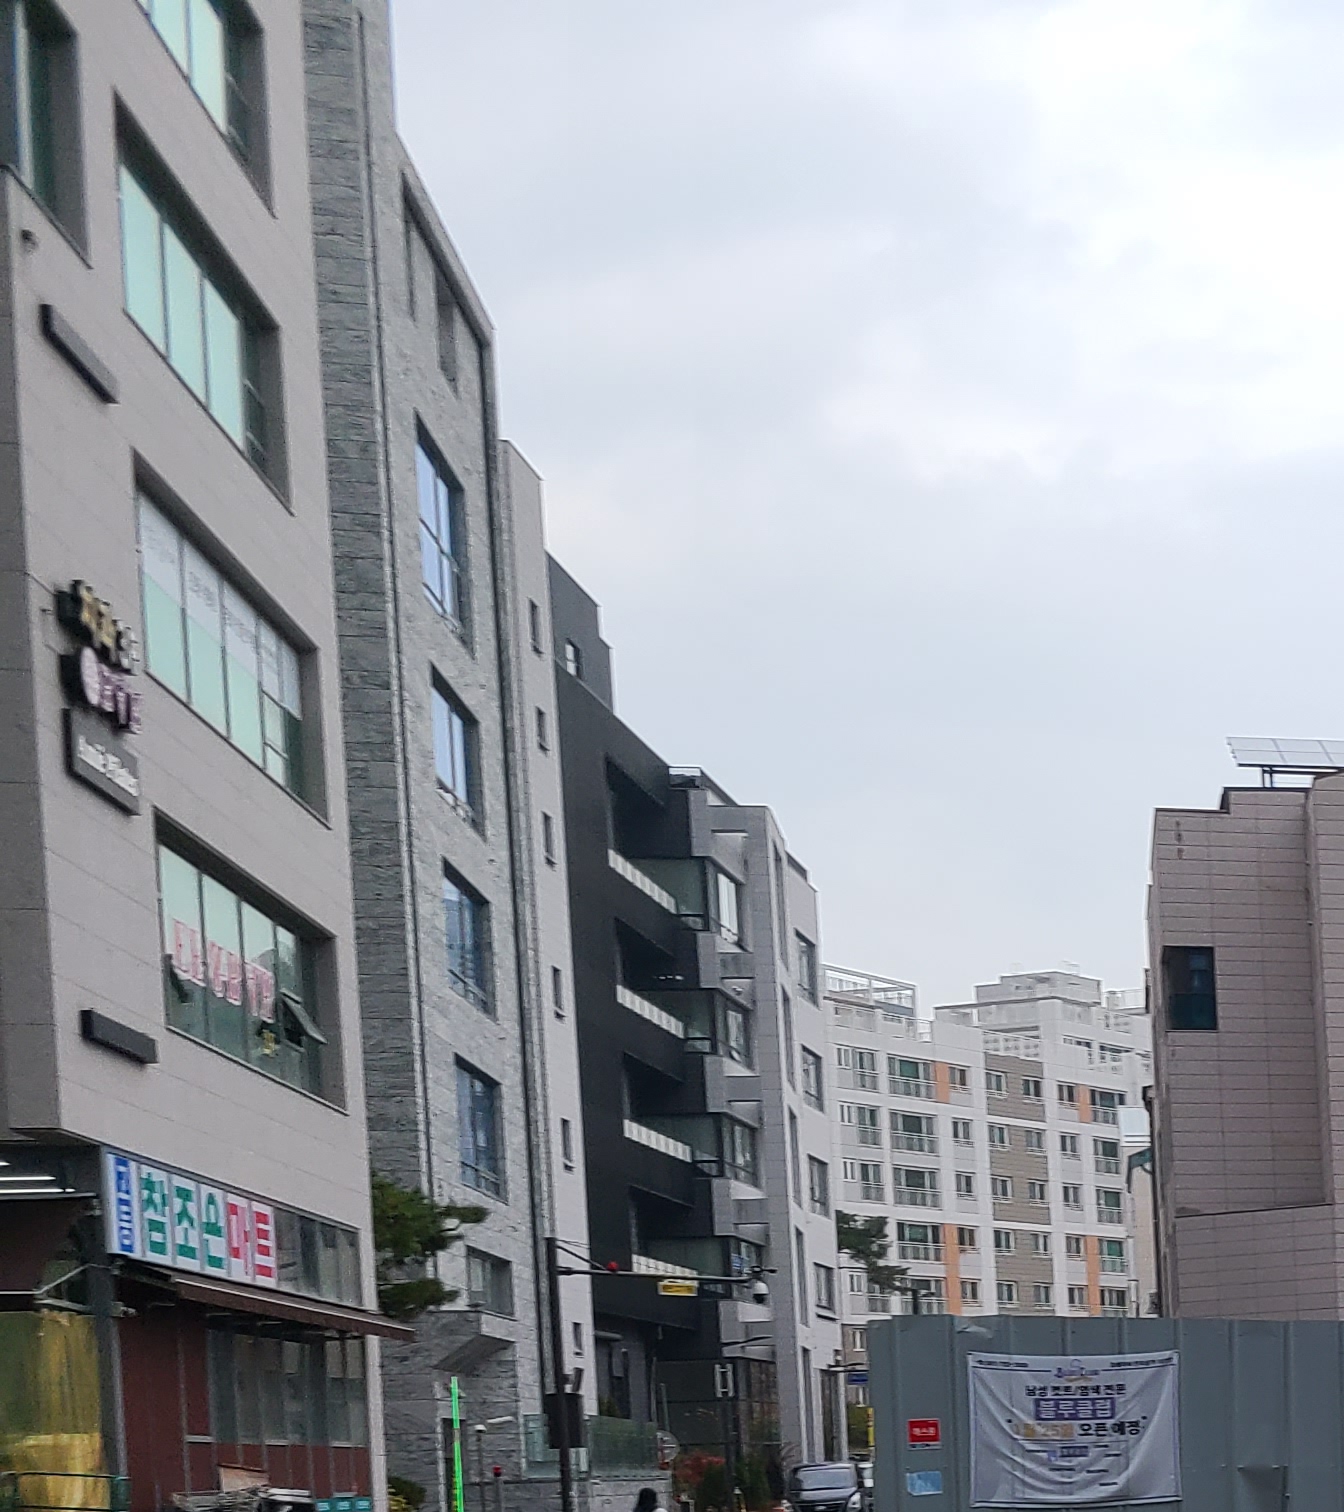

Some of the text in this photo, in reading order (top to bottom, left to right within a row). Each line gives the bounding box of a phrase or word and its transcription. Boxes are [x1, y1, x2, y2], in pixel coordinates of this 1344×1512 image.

[140, 1172, 276, 1278] 참조은마트
[1025, 1385, 1048, 1397] 남성
[1037, 1398, 1113, 1419] 블루클럽
[1077, 1422, 1107, 1437] 오픈
[1110, 1419, 1141, 1436] 예정
